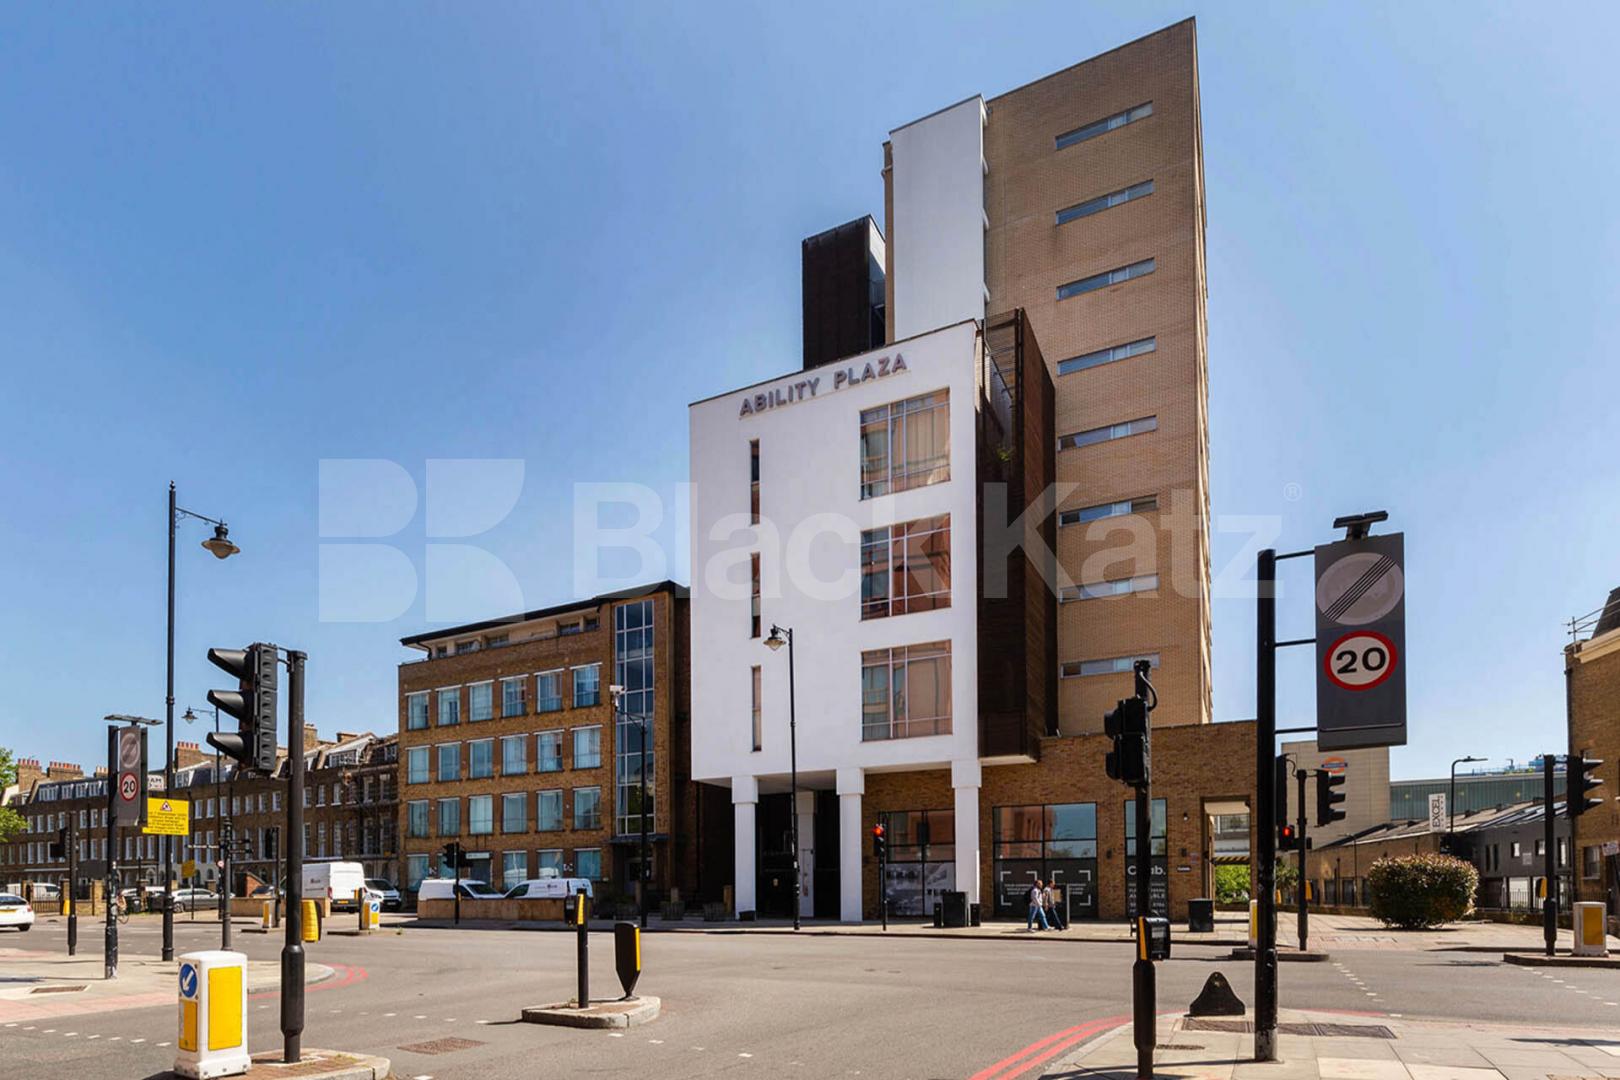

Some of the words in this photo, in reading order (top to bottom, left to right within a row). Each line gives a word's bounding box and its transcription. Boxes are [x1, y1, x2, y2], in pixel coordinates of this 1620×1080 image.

[739, 377, 820, 416] ABILITY
[834, 353, 907, 390] PLAZA
[1335, 646, 1387, 675] 20
[123, 780, 135, 794] 20
